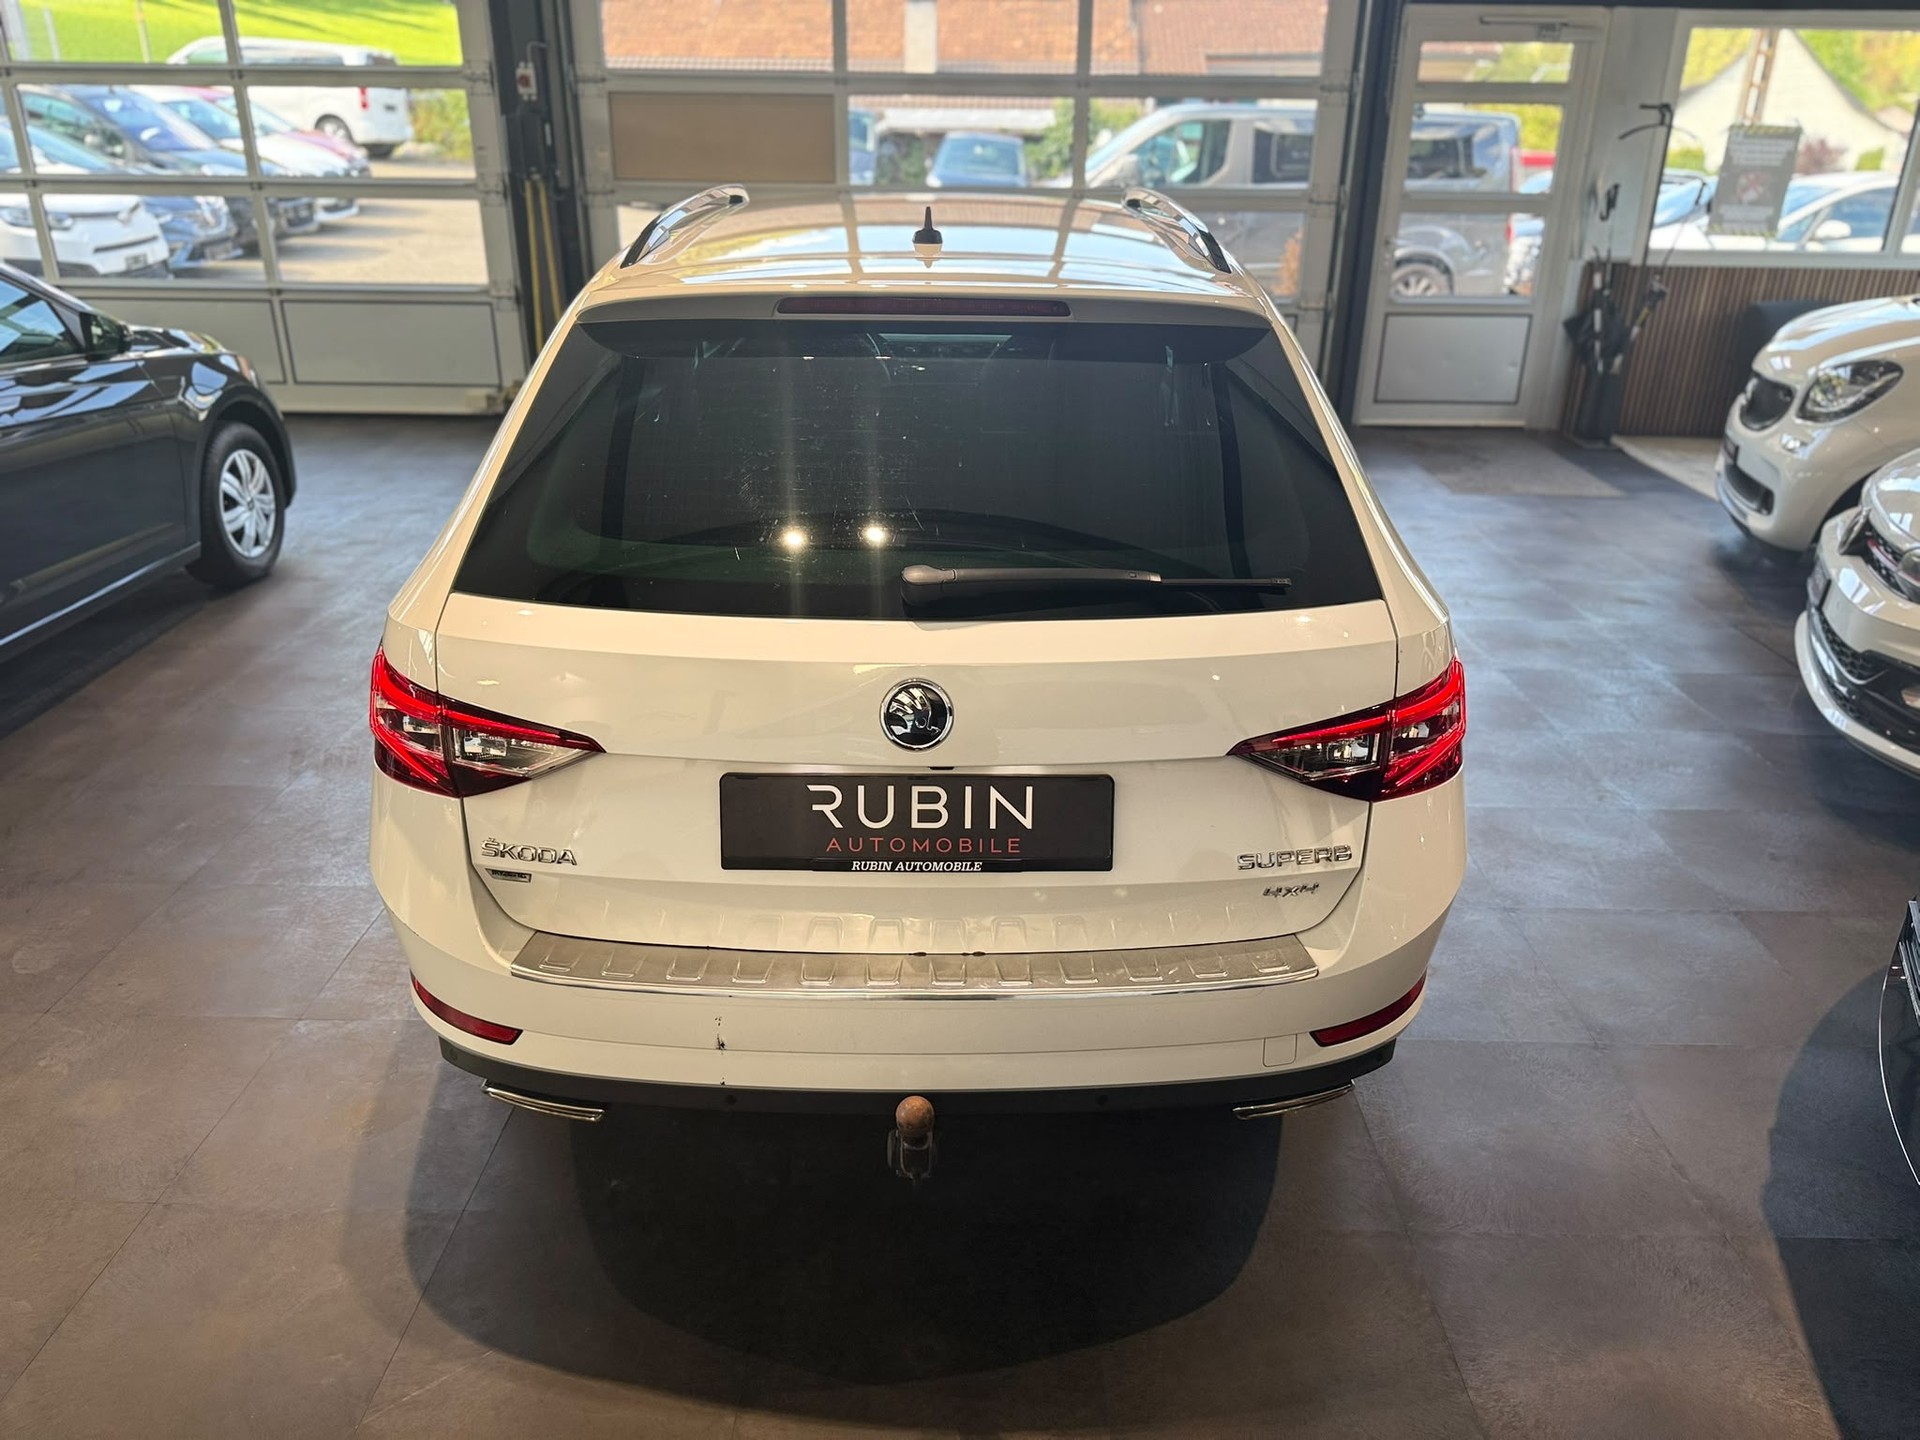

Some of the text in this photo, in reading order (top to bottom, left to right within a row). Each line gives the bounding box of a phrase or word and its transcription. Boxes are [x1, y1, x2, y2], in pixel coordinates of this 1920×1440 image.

[806, 784, 1033, 829] RUBIN
[481, 837, 577, 865] ŠKODA
[825, 837, 1021, 853] AUTOMOBILE
[1237, 845, 1352, 870] SUPERB
[850, 860, 982, 872] RUBIN AUTOMOBILE
